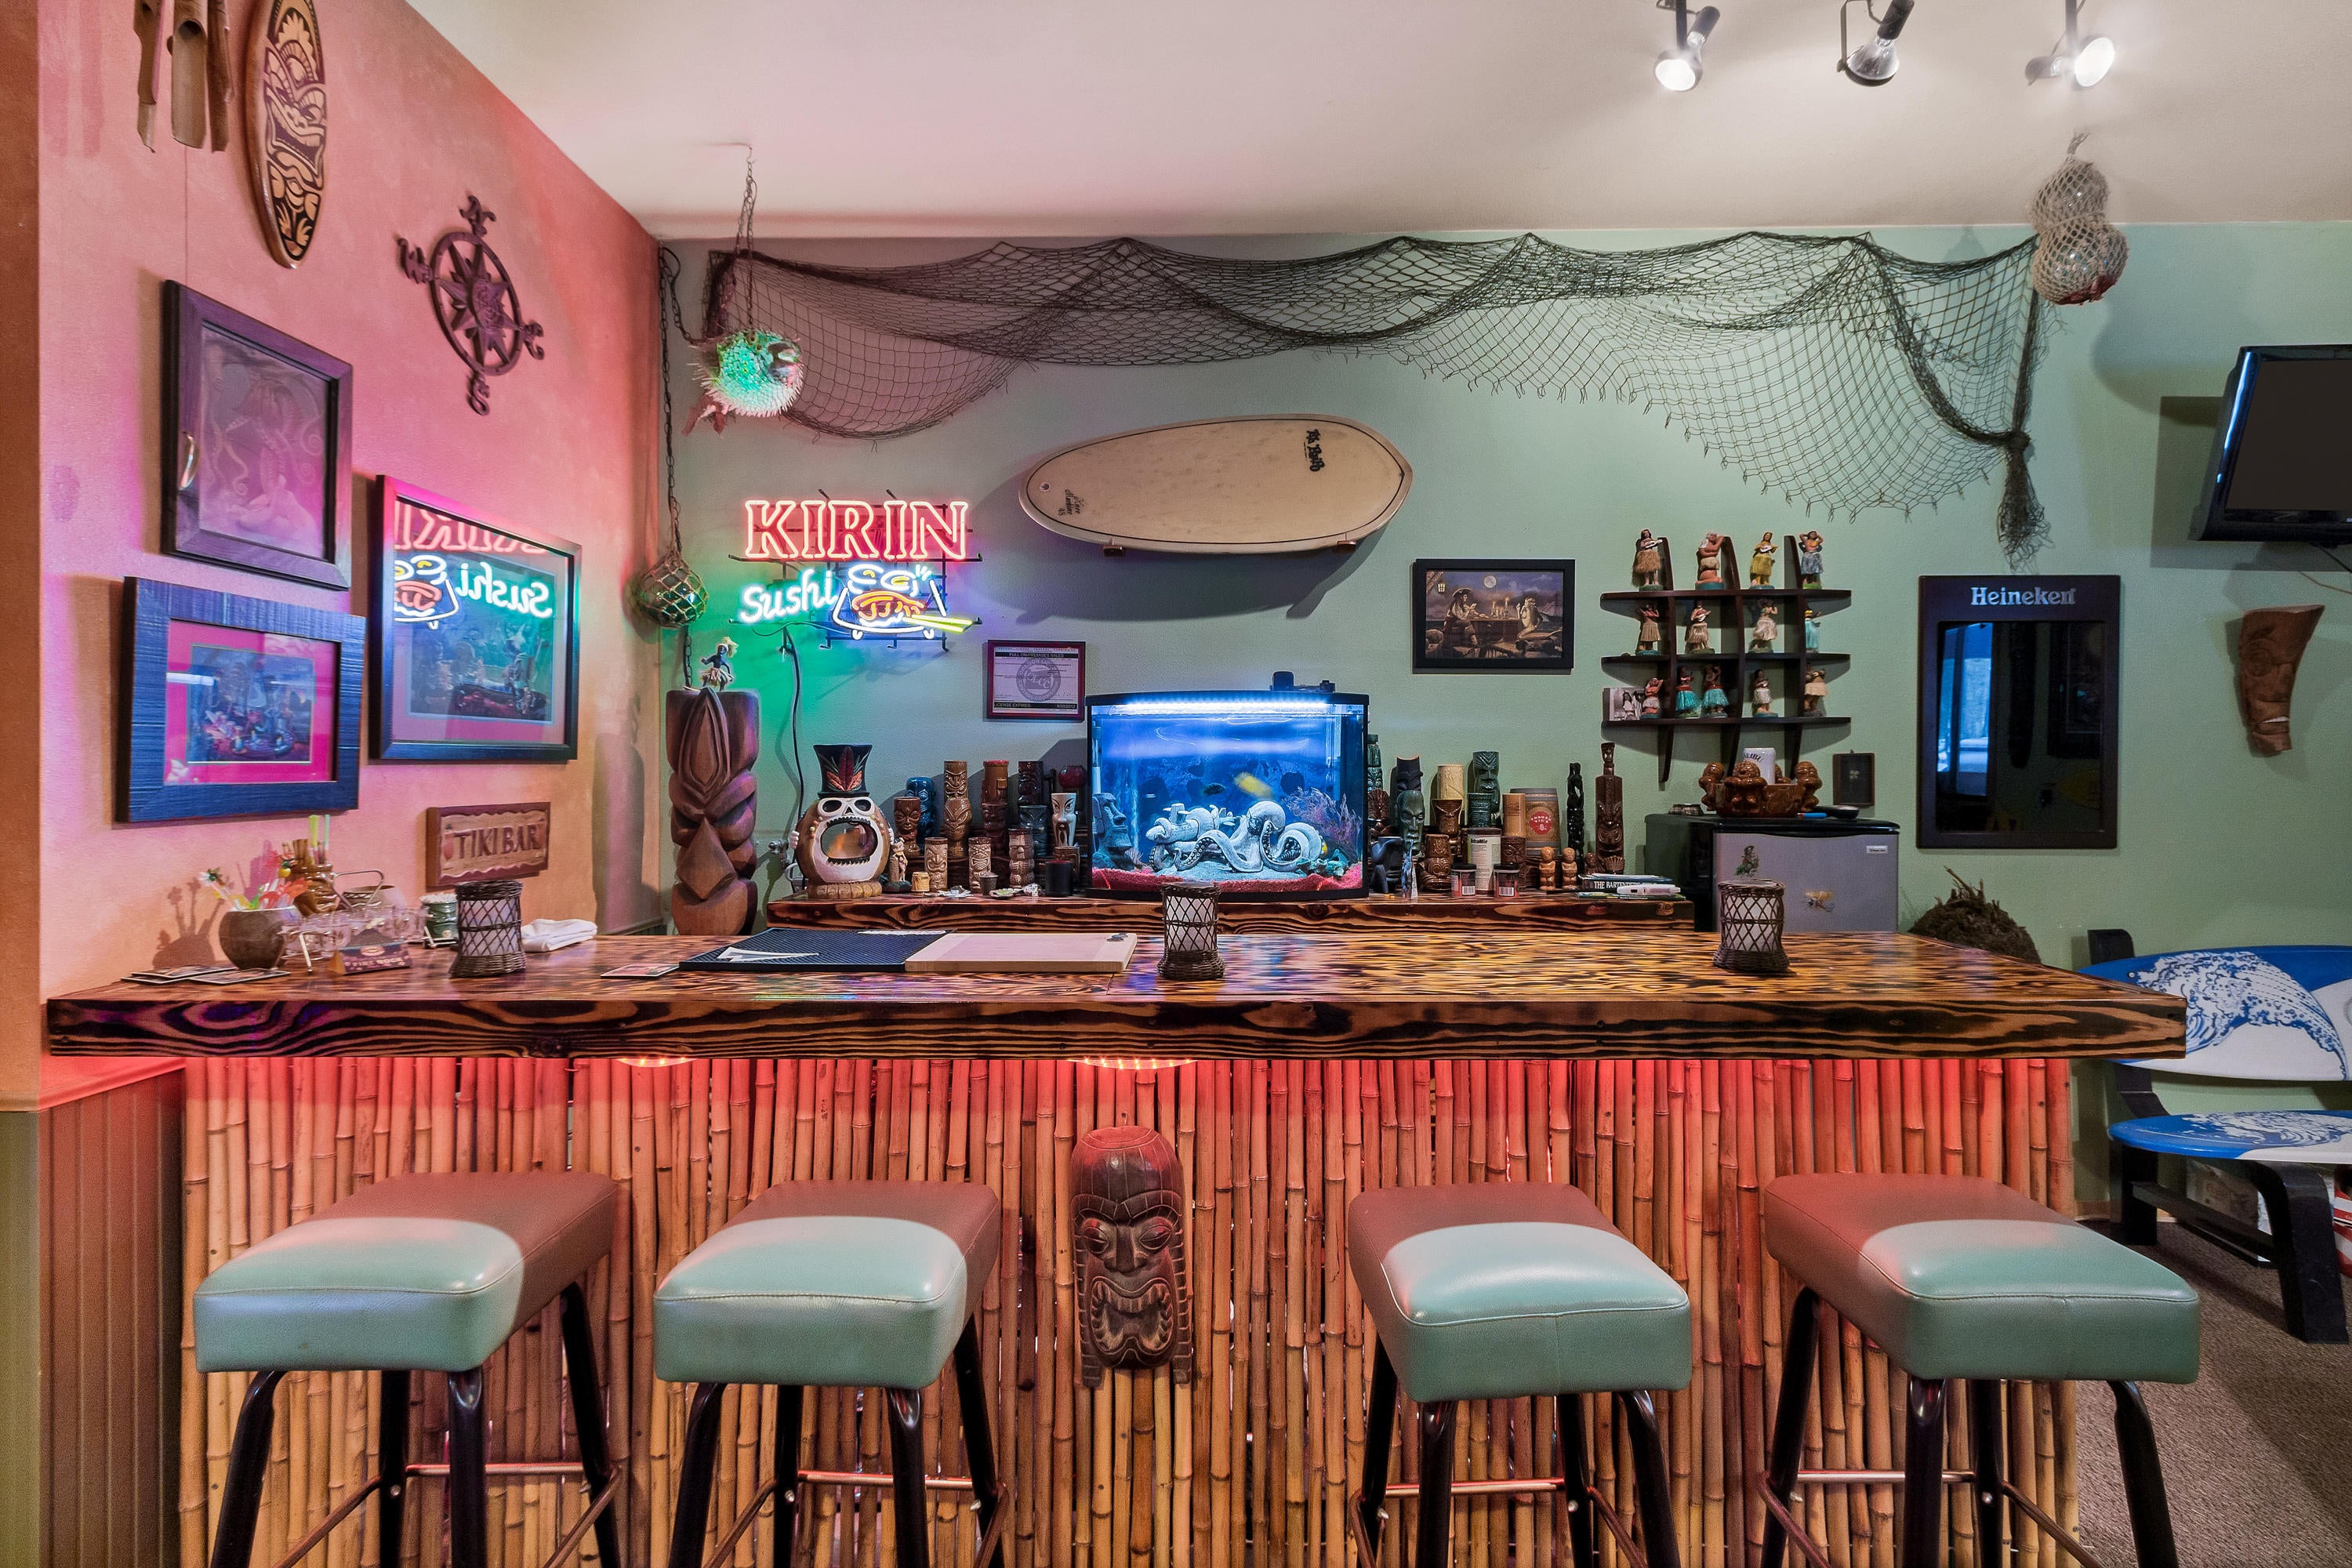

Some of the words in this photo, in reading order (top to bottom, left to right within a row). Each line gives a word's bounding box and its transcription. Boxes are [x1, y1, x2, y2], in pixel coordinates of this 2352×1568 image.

[745, 499, 969, 560] KIRIN
[739, 567, 838, 623] Sushi
[1970, 586, 2076, 605] Heineken
[453, 827, 498, 859] TIKI
[502, 823, 540, 854] BAR
[1594, 880, 1605, 889] THE
